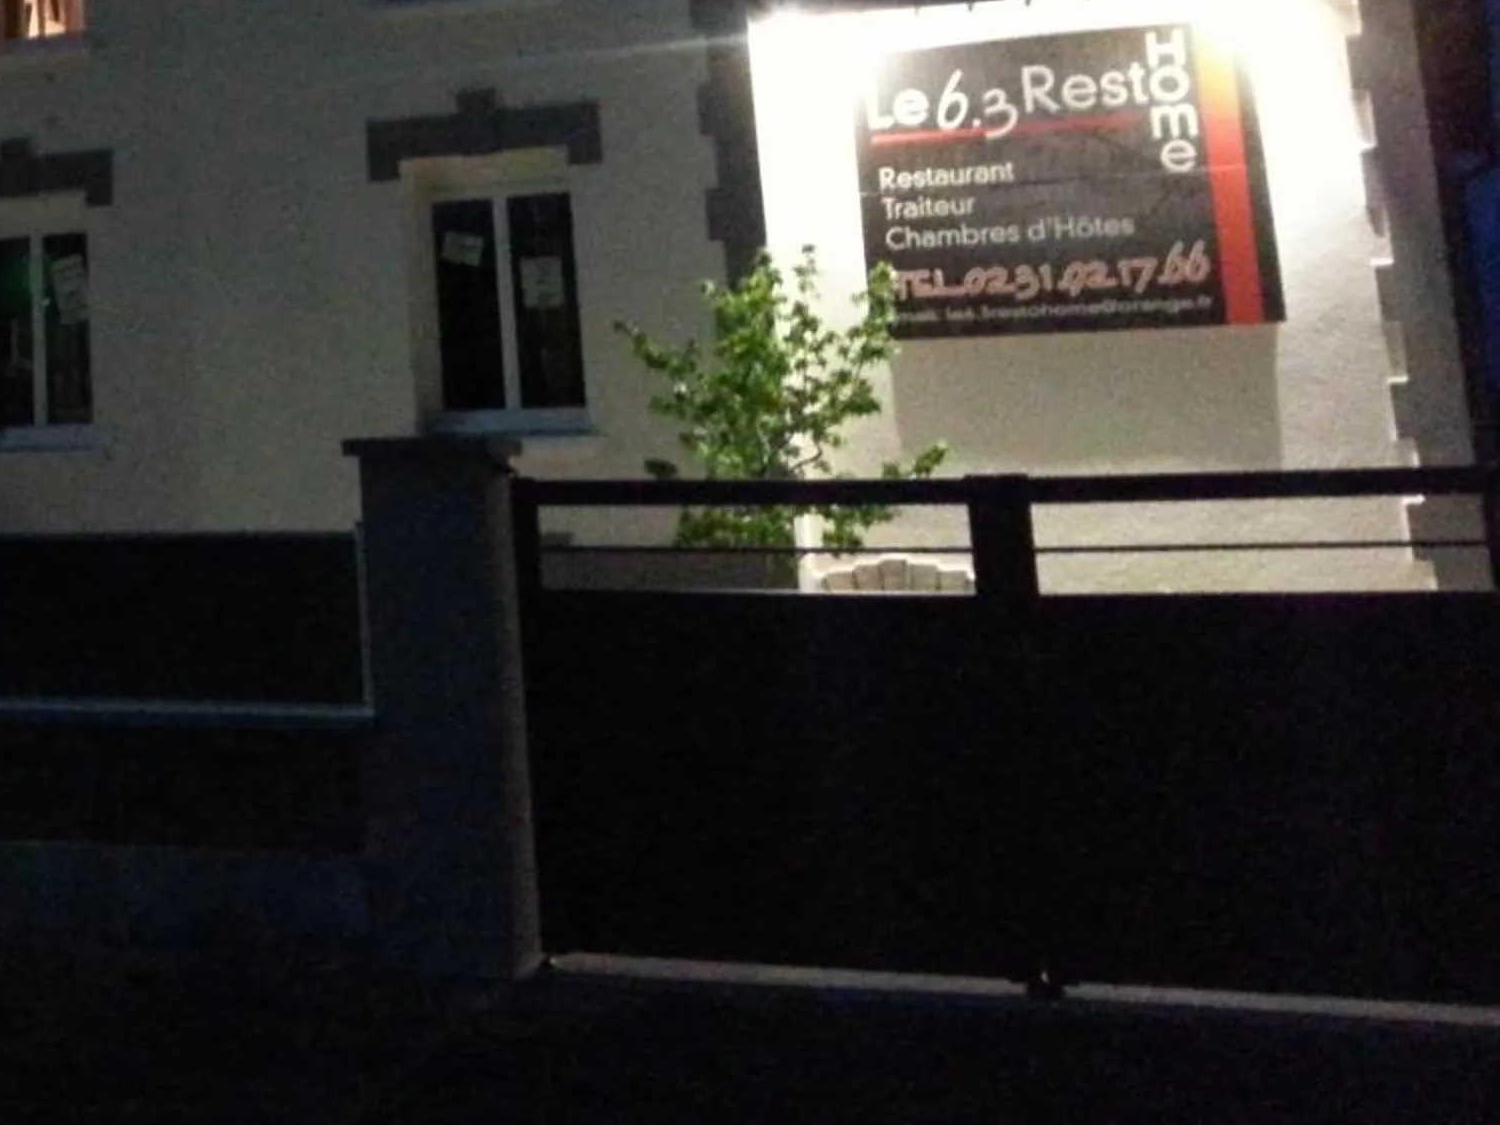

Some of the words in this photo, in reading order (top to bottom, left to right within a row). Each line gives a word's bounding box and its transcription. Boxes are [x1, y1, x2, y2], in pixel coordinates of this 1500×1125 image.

[878, 162, 1015, 190] Restaurant
[881, 196, 976, 220] Traiteur
[885, 223, 1020, 251] Chambres
[1027, 215, 1136, 246] d'Hôtes
